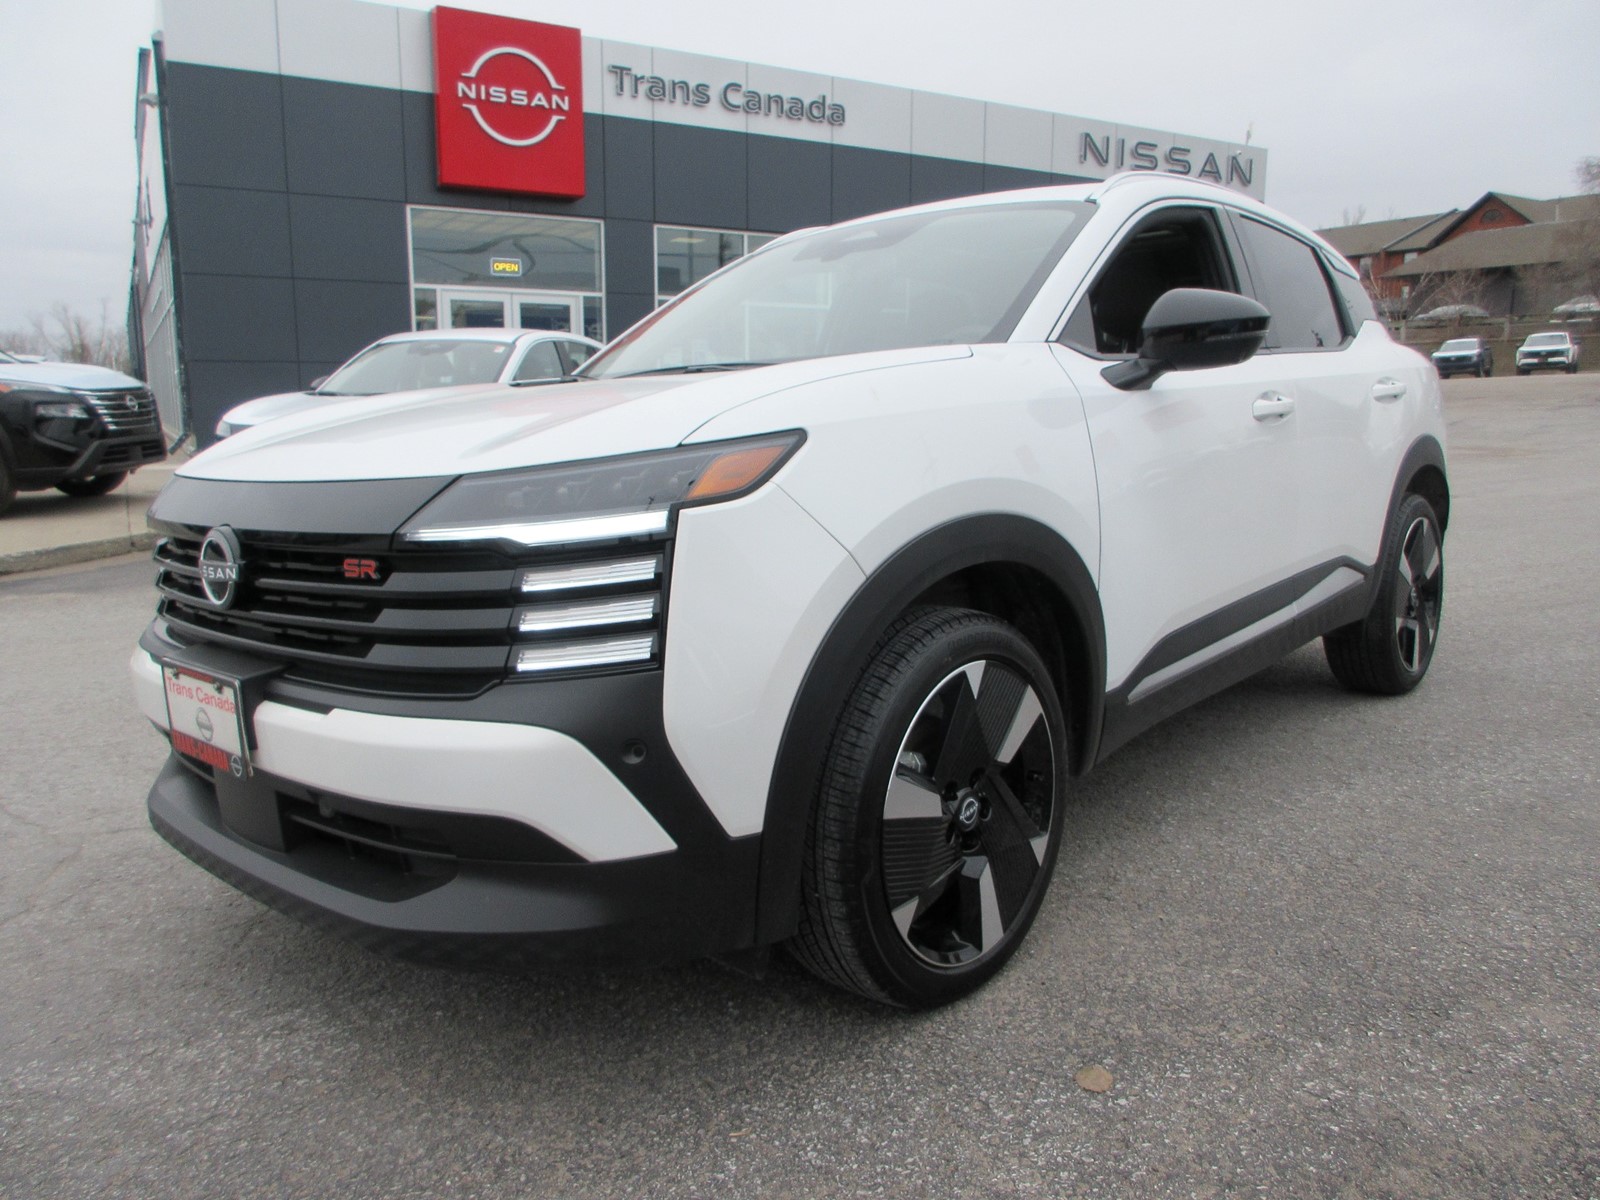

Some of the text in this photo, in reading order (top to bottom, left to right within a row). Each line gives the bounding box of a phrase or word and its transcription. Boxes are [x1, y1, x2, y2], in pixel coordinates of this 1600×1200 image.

[457, 81, 570, 112] NISSAN
[608, 64, 846, 127] Trans Canada
[1079, 131, 1253, 186] NISSAN
[493, 262, 519, 272] OPEN
[202, 565, 237, 579] SSAN
[343, 559, 378, 579] SR
[165, 676, 236, 714] Trans Canada
